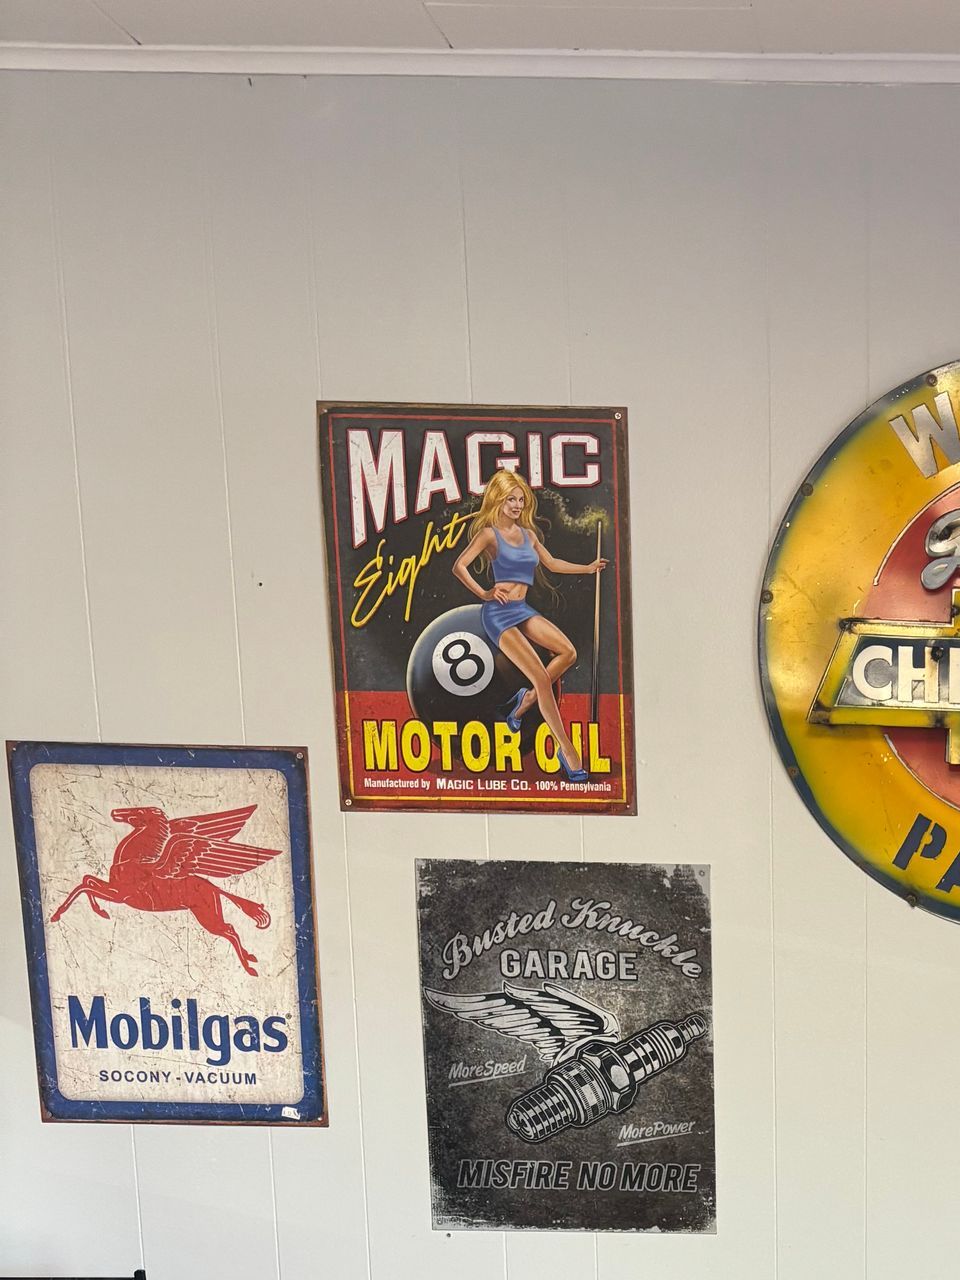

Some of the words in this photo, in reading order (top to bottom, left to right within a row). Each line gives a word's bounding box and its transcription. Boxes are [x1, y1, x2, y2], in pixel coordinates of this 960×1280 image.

[346, 427, 601, 550] MAGIC
[351, 511, 480, 628] Eight
[442, 638, 485, 687] 8
[363, 718, 523, 773] MOTOR
[534, 721, 612, 774] OIL
[364, 778, 419, 789] Manufactured
[421, 778, 430, 791] by
[535, 780, 558, 791] 100%
[560, 781, 611, 792] Pennsylvania
[441, 900, 557, 980] Busted
[561, 897, 703, 979] Knuckle
[500, 950, 638, 981] GARAGE
[67, 994, 288, 1066] Mobilgas
[457, 1159, 571, 1190] MISFIRE
[577, 1161, 618, 1191] NO
[619, 1162, 701, 1193] MORE
